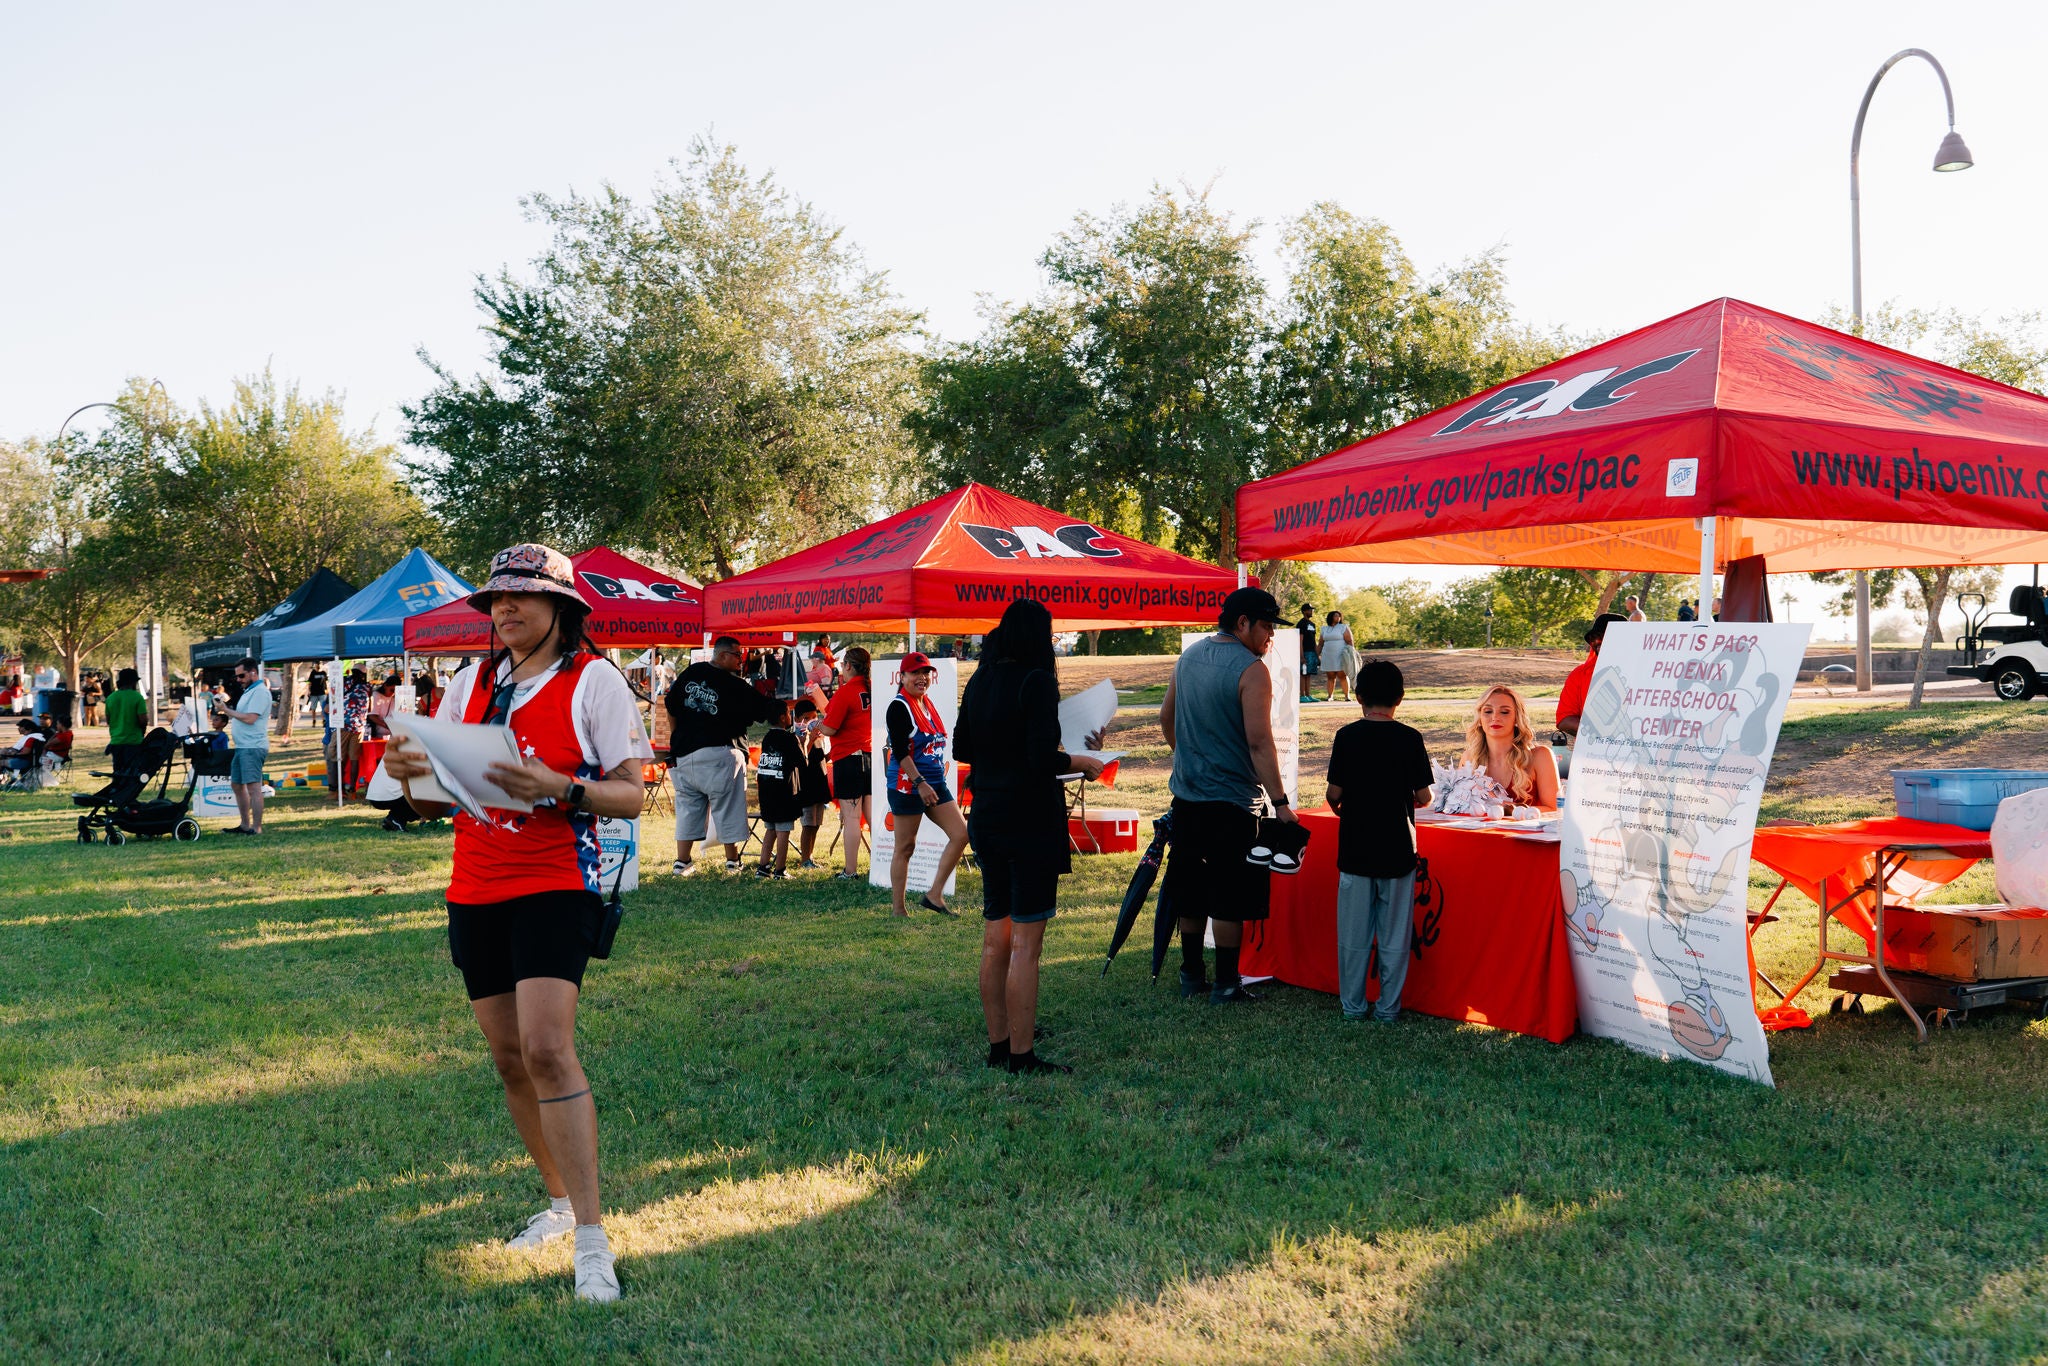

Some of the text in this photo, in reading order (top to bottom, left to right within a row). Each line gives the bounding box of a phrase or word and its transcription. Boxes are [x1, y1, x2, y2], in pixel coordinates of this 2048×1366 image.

[1431, 348, 1703, 437] PAC
[1273, 449, 1641, 533] www.phoenix.gov/parks/pac
[959, 522, 1123, 559] PAC
[579, 571, 698, 604] PAC
[721, 579, 884, 619] www.phoenix.gov/parks/pac
[955, 578, 1228, 612] www.phoenix.gov/parks/pac
[355, 635, 404, 647] www.p
[1643, 633, 1758, 653] WHAT IS PAC?
[1652, 661, 1726, 681] PHOENIX
[1623, 688, 1738, 711] AFTERSCHOOL
[1640, 717, 1703, 738] CENTER
[1604, 737, 1625, 745] Phoenix
[1626, 739, 1640, 747] Parks
[1653, 742, 1682, 750] Recreation
[1684, 744, 1725, 755] Department's
[1659, 759, 1669, 768] fun,
[1672, 761, 1703, 771] supportive
[1717, 765, 1755, 775] educational
[1582, 767, 1595, 776] place
[1657, 775, 1674, 783] spend
[1676, 777, 1695, 785] critical
[1697, 779, 1730, 788] afterschool
[1732, 782, 1751, 791] hours.
[1623, 787, 1642, 796] offered
[1650, 790, 1668, 799] school
[1683, 794, 1710, 805] citywide.
[1582, 799, 1737, 826] Experienced recreation staff lead structured activities and
[1623, 822, 1680, 838] supervised free-play.
